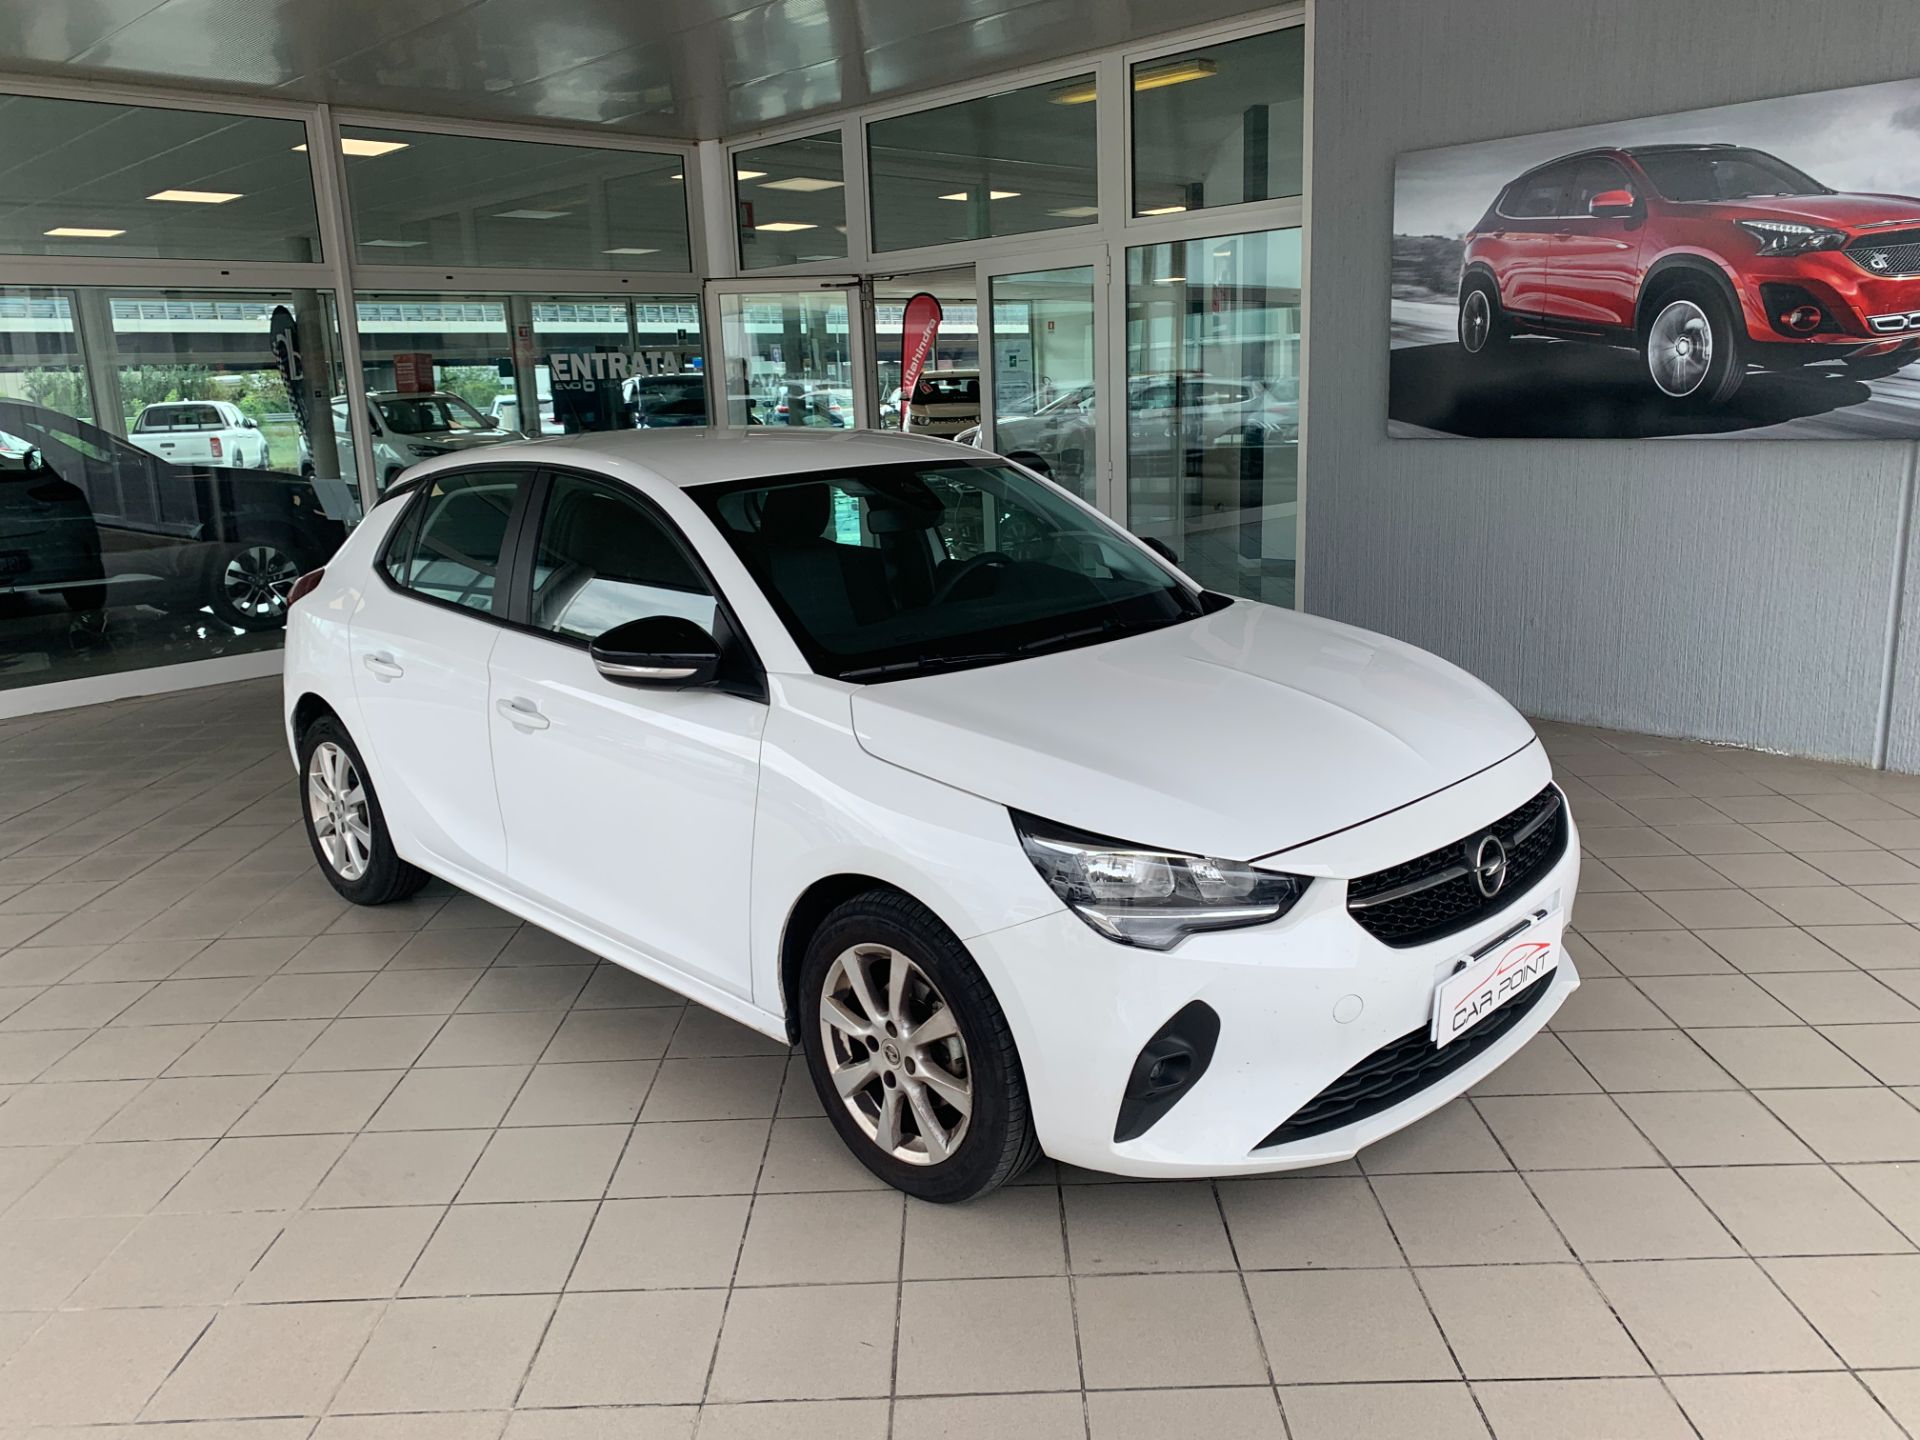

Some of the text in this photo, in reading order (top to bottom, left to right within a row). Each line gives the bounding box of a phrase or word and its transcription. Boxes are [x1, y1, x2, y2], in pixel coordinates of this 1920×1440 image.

[550, 352, 680, 381] ENTRATA
[1452, 950, 1550, 1032] CAR POINT
